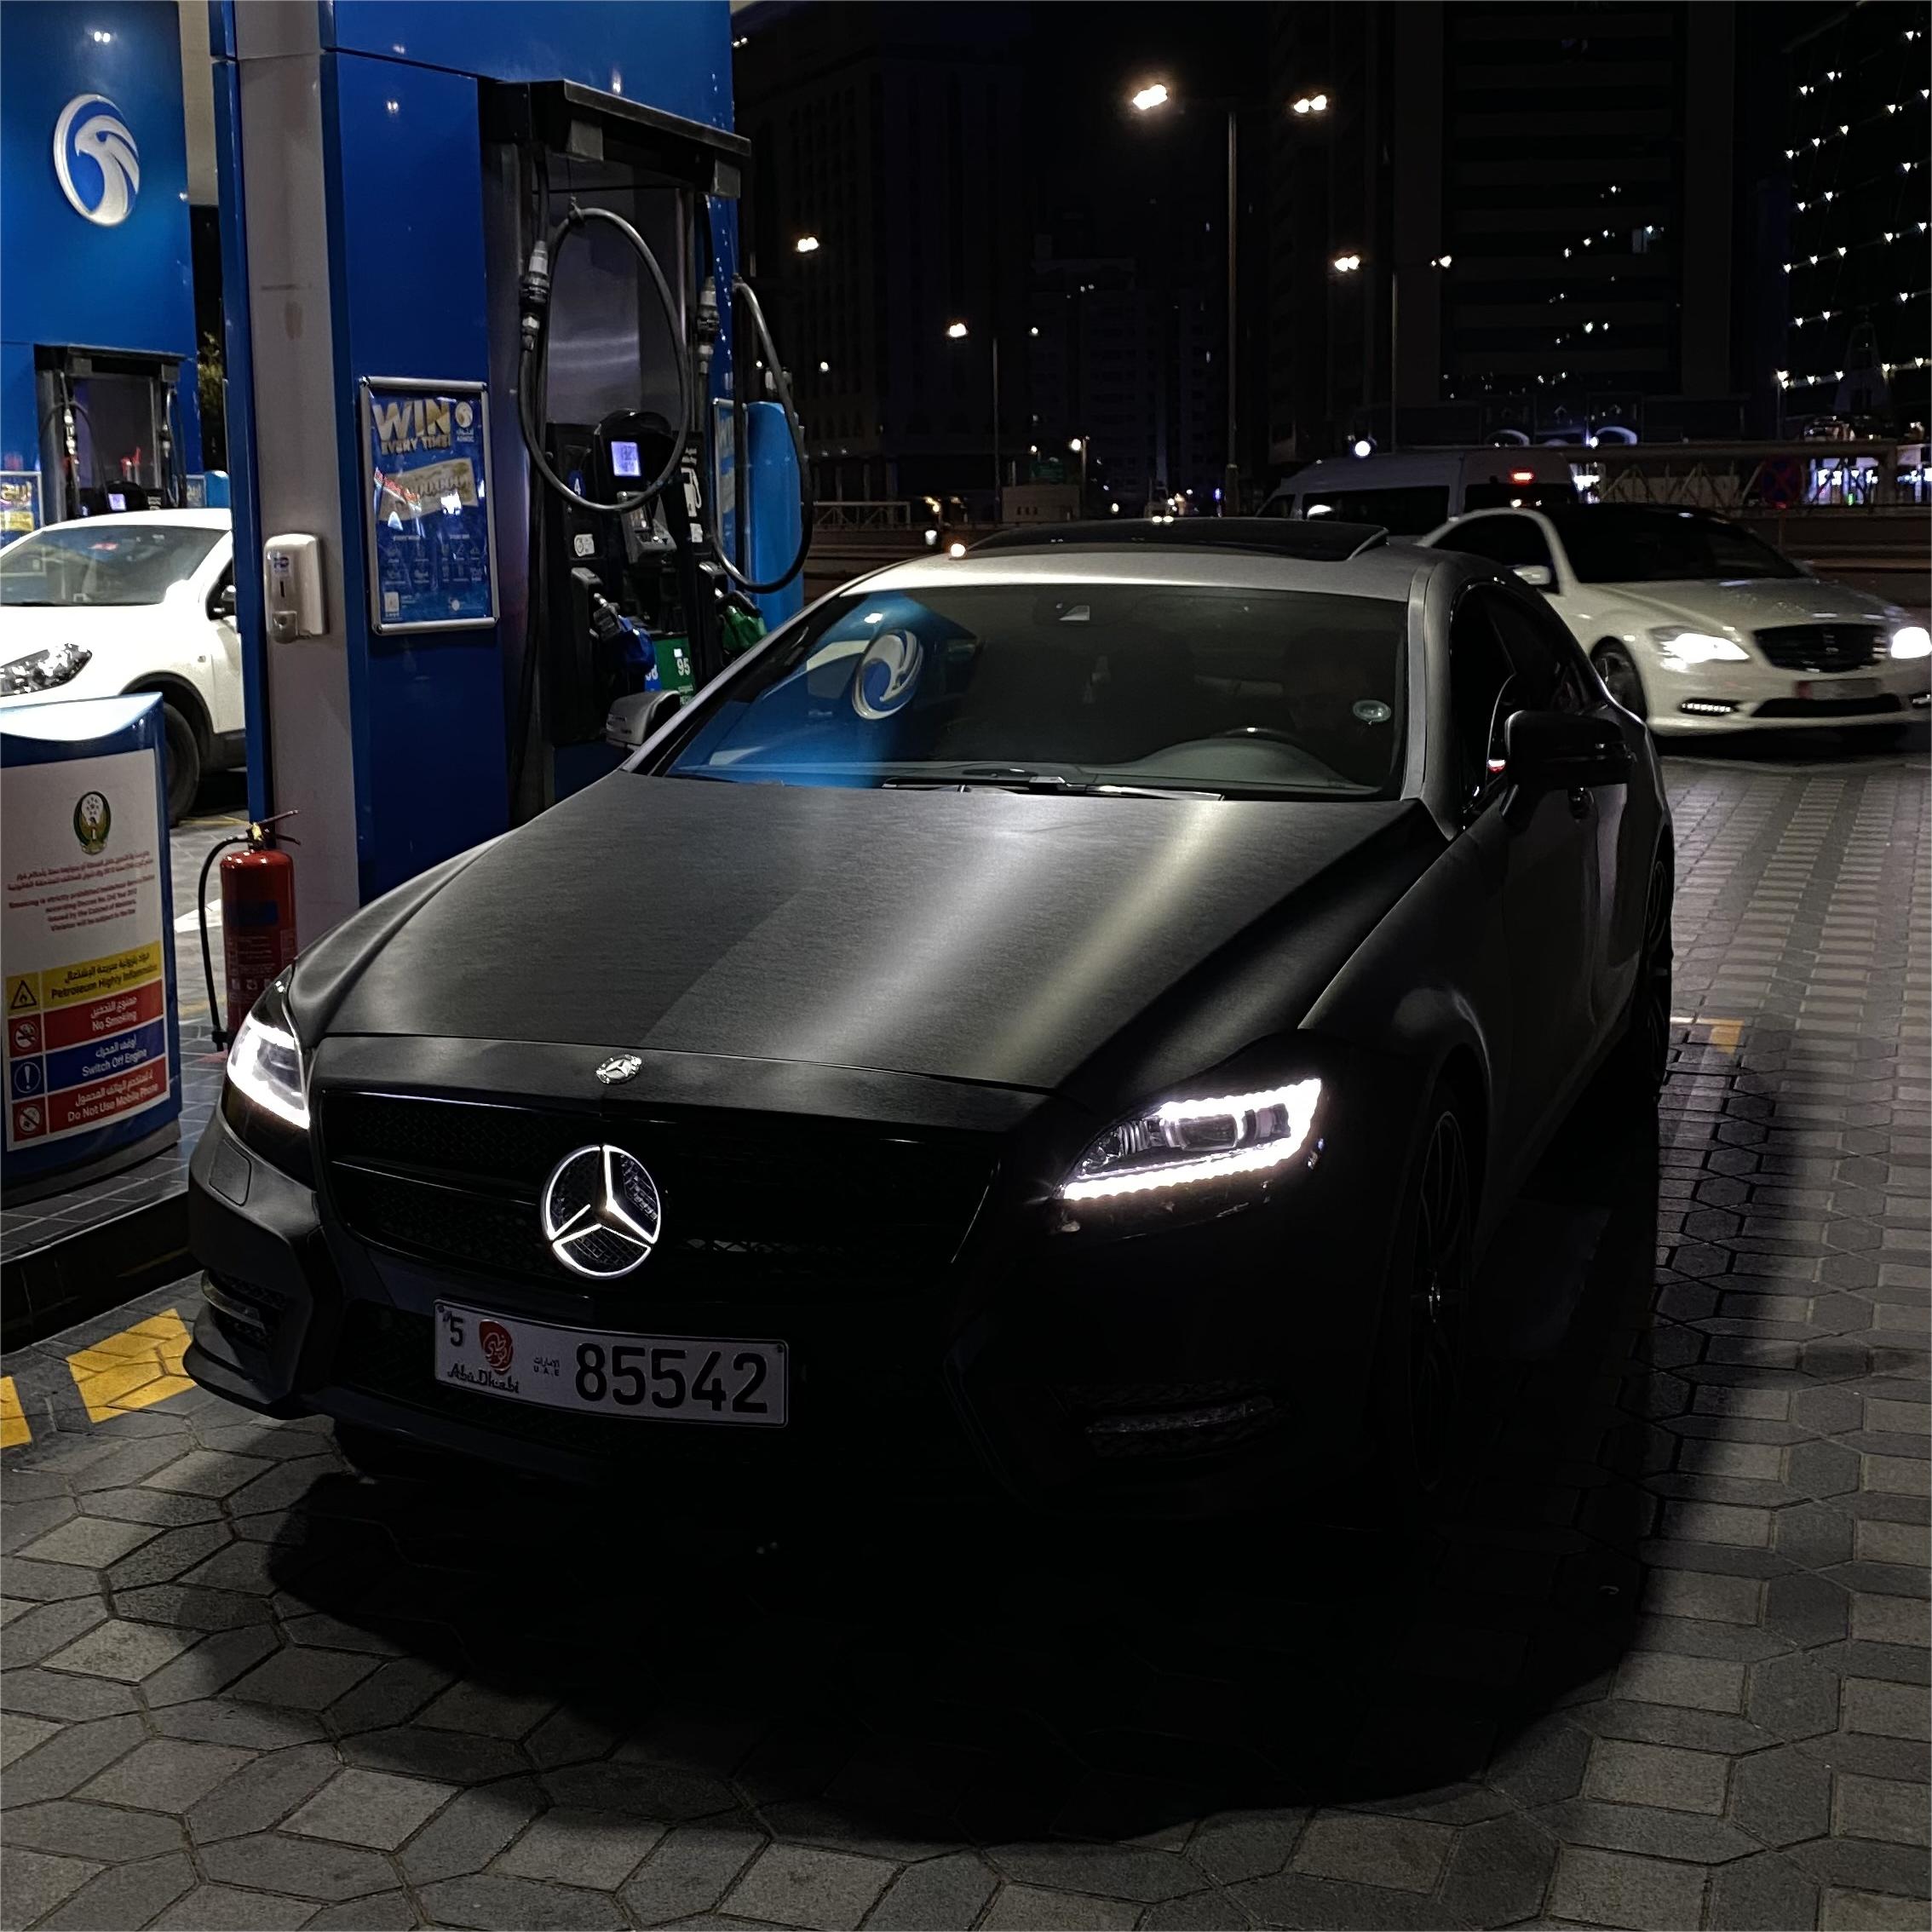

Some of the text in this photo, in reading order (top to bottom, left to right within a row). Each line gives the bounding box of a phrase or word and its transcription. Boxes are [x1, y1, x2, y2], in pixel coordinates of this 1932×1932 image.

[372, 398, 451, 440] WIN
[676, 658, 691, 676] 95
[52, 982, 96, 998] Petroleum
[99, 975, 122, 988] Highly
[92, 1010, 137, 1032] No Smoking
[81, 1049, 148, 1078] Switch Off Engine
[67, 1084, 159, 1123] Do Not Use Mobile Phone
[450, 1317, 464, 1347] 5
[447, 1363, 519, 1393] Abu Dhabi
[575, 1343, 768, 1414] 85542
